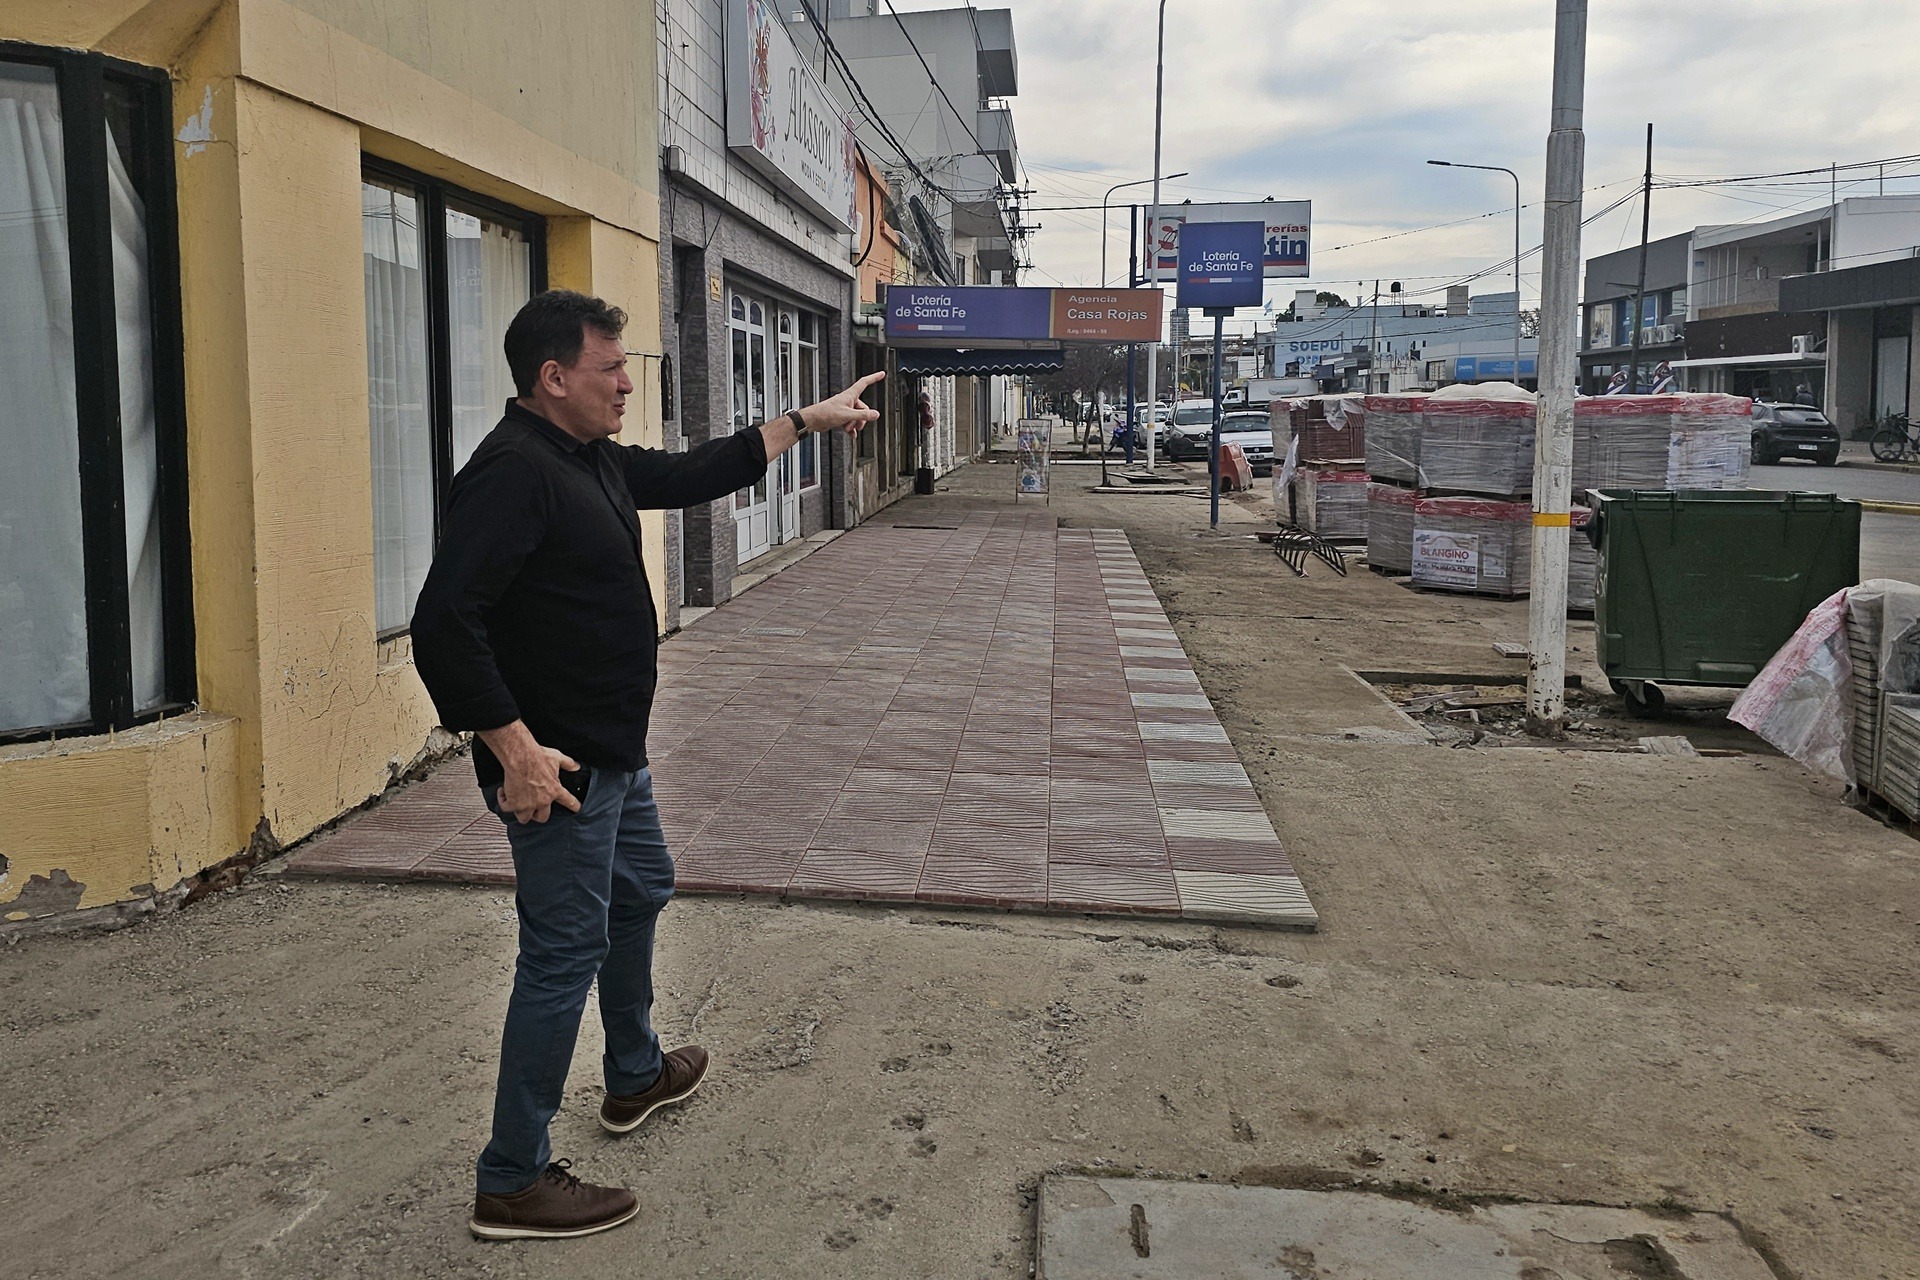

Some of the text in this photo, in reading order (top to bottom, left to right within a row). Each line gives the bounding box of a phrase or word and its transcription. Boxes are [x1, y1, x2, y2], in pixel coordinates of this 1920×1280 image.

[784, 66, 832, 173] Alisson
[1263, 235, 1307, 255] tin
[1202, 250, 1240, 261] Lotería
[1188, 261, 1254, 272] de Santa Fe
[911, 294, 952, 306] Lotería
[1068, 295, 1118, 304] Agencia
[895, 306, 966, 318] de Santa Fe
[1067, 308, 1148, 322] Casa Rojas
[1289, 340, 1340, 352] SOEPU
[1420, 547, 1470, 560] BLANGINO
